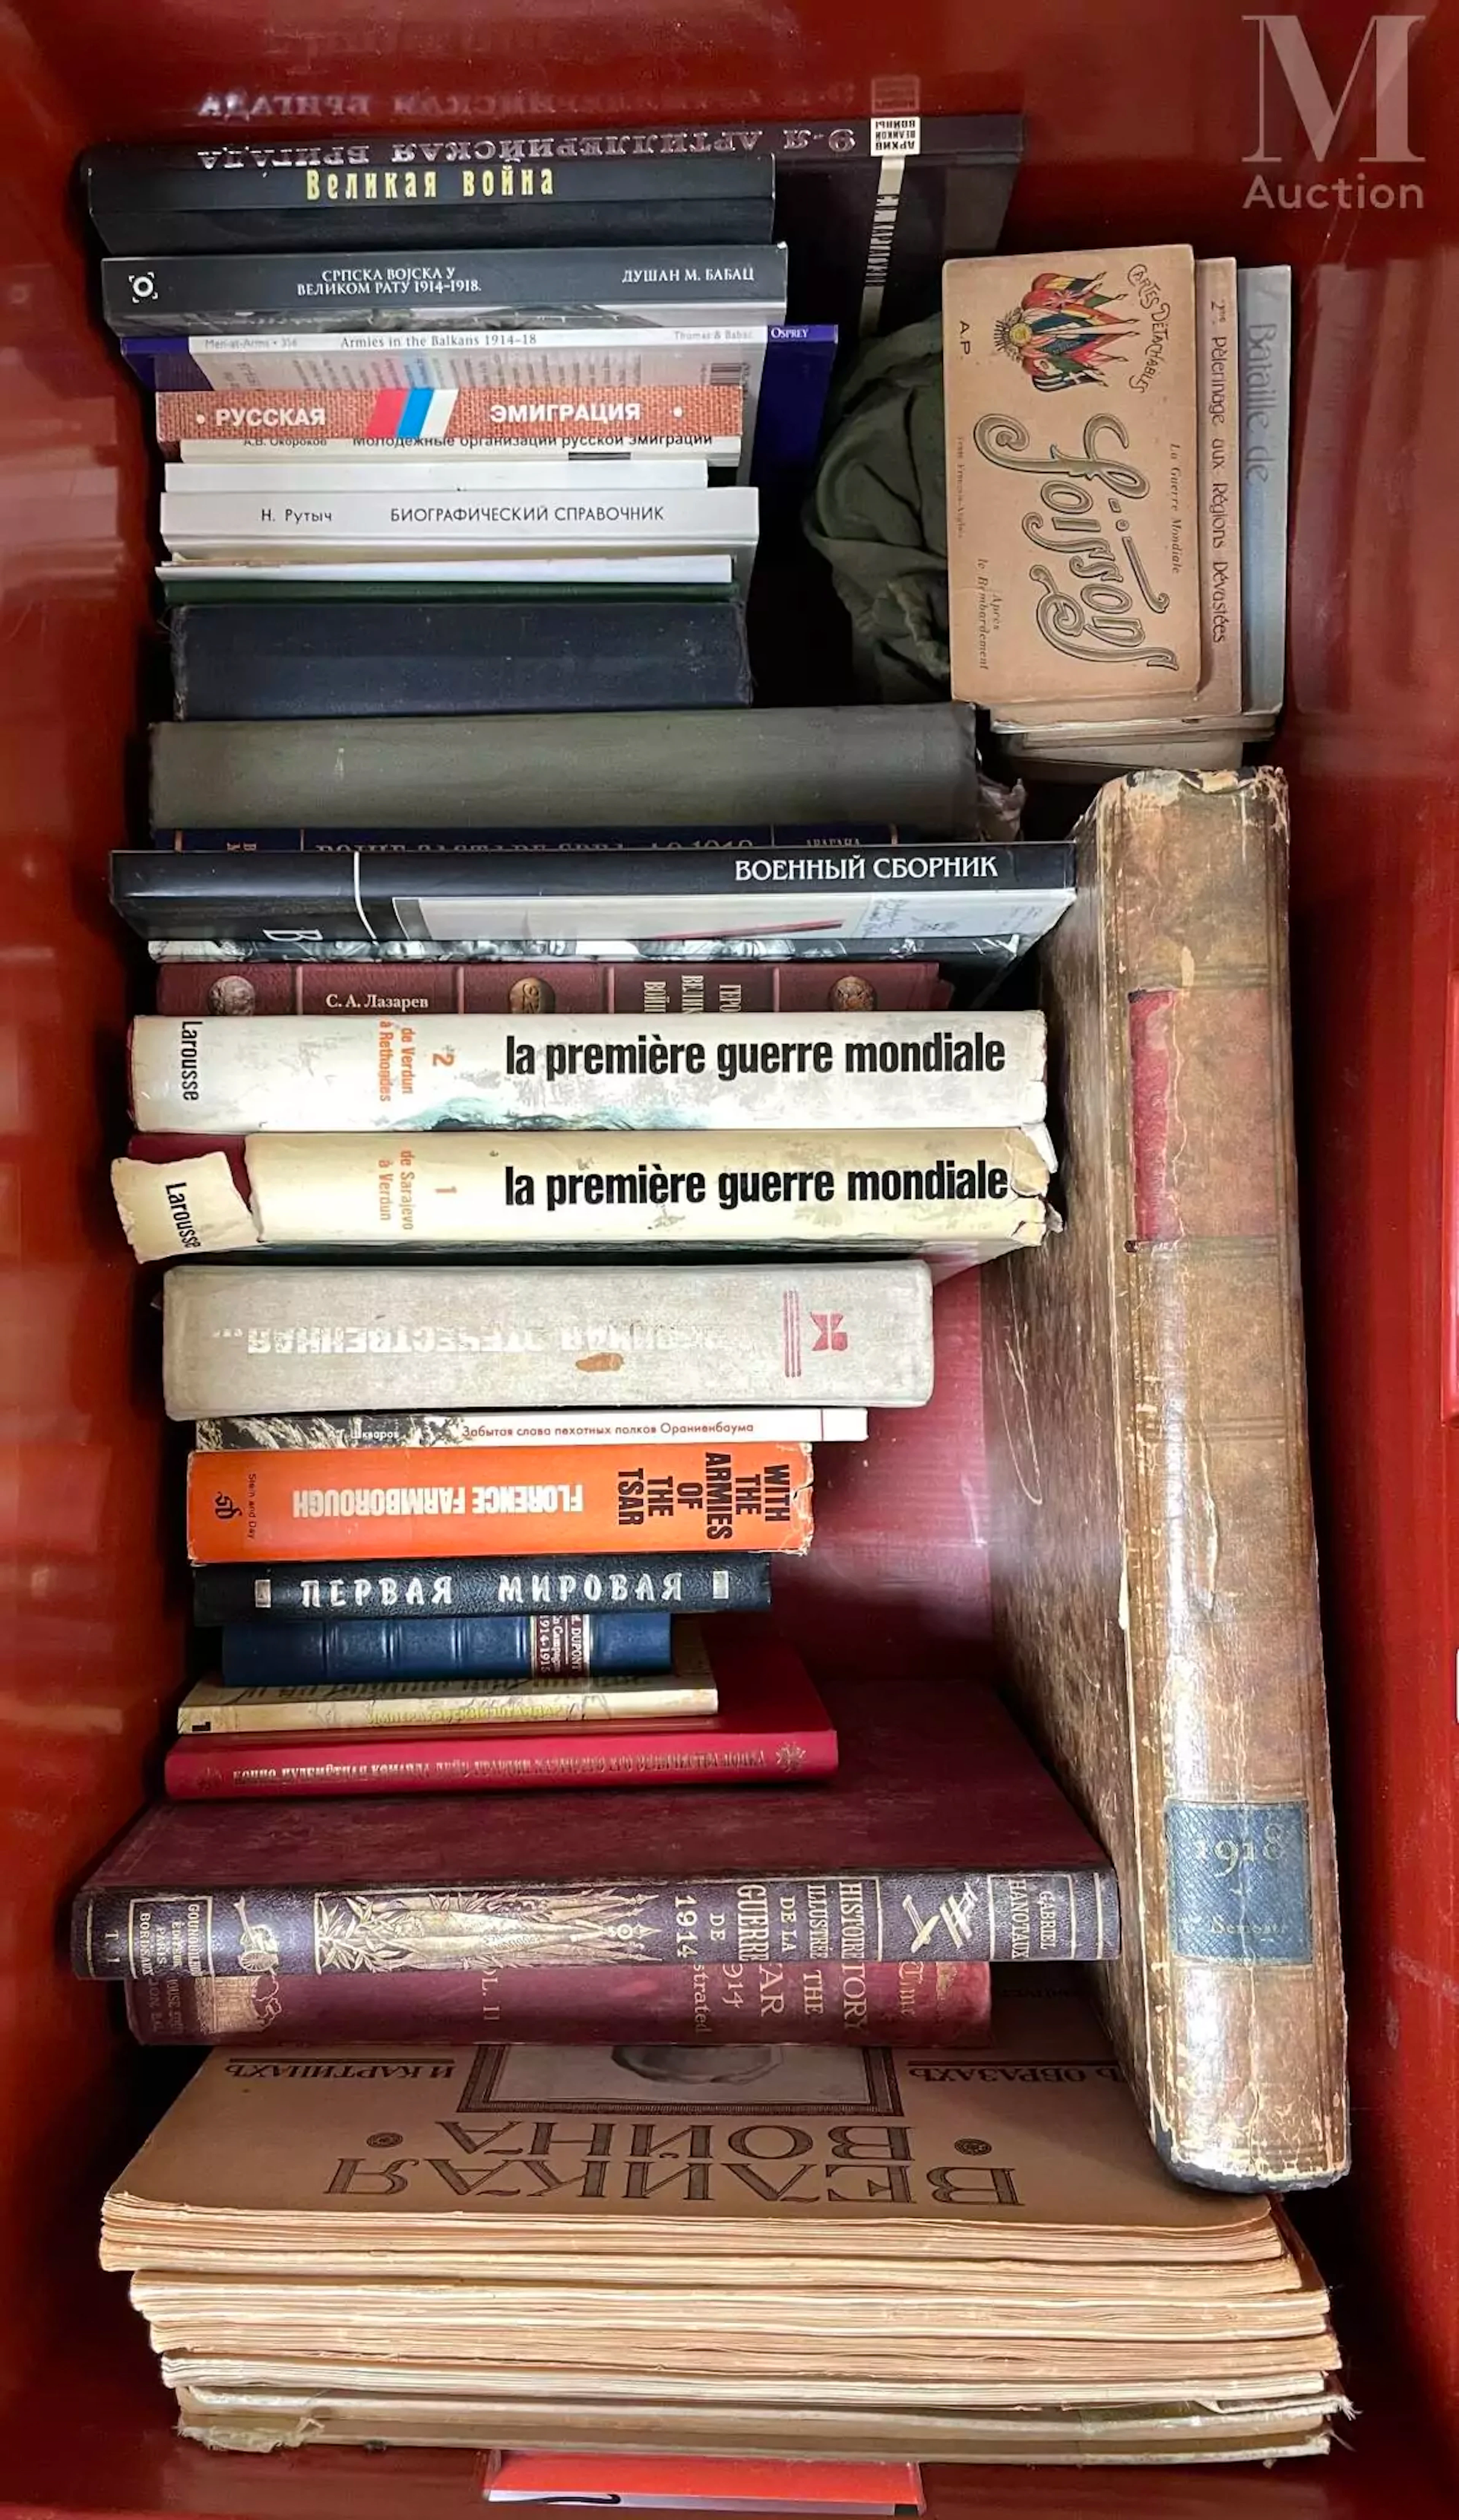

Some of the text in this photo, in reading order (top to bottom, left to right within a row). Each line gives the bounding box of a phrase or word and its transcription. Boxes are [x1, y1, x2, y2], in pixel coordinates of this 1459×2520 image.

[875, 119, 916, 129] ВОЙНЫ
[875, 129, 916, 139] ВЕЛИКОЙ
[198, 144, 370, 169] БРИГАДА
[391, 130, 763, 164] АРТИЛЛЕРИЙСКАЯ
[875, 140, 916, 151] АРХИВ
[306, 165, 554, 201] Великая война
[298, 278, 482, 296] ВЕЛИКОМ РАТУ 1914-1918.
[322, 265, 455, 280] СРПСКА ВОЈСКА У
[622, 266, 755, 284] ДУШАН М. БАБАЦ
[1127, 263, 1161, 309] CARTES
[205, 337, 269, 348] Men-at-Arms
[340, 336, 384, 348] Armies
[388, 336, 402, 347] in
[407, 335, 428, 347] the
[431, 334, 479, 347] Balkans
[674, 330, 712, 341] Thomas
[715, 330, 722, 340] &
[1210, 337, 1228, 424] Pèlerinage
[215, 407, 327, 428] РУССКАЯ
[490, 403, 641, 424] ЭМИГРАЦИЯ
[1245, 323, 1278, 483] Bataille de
[1212, 438, 1226, 470] aux
[261, 505, 664, 526] Н. Рутыч БИОГРАФИЧЕСКИЙ СПРАВОЧНИК
[1170, 443, 1183, 575] La Guerre Mondiale
[1210, 483, 1229, 549] Régions
[1212, 562, 1230, 643] Dévastées
[735, 855, 999, 881] ВОЕННЫЙ СБОРНИК
[326, 993, 429, 1011] С. А. Лазарев
[644, 980, 666, 1013] ВОЙН
[681, 974, 704, 1014] ВЕЛИК
[719, 984, 741, 1013] ГЕРО
[182, 1020, 203, 1101] Larousse
[379, 1020, 392, 1102] à Rethondes
[400, 1026, 414, 1095] de Verdun
[432, 1052, 455, 1068] 2
[506, 1032, 1005, 1082] la première guerre mondiale
[379, 1159, 391, 1221] à Verdun
[401, 1150, 415, 1231] de Sarajevo
[505, 1159, 1008, 1211] la première guerre mondiale
[166, 1182, 201, 1249] Larousse
[462, 1422, 754, 1437] Забытая слава пехотных полков Ораниенбаума
[247, 1473, 257, 1540] Stein and Day
[293, 1483, 584, 1518] FLORENCE FARMBOROUGH
[618, 1468, 644, 1525] TSAR
[647, 1476, 674, 1517] THE
[677, 1482, 703, 1509] OF
[706, 1452, 733, 1540] ARMIES
[735, 1474, 761, 1516] THE
[764, 1464, 790, 1522] WITH
[301, 1572, 683, 1608] ПЕРВАЯ МИРОВАЯ
[570, 1627, 582, 1671] DUPONT
[674, 1895, 698, 1958] 1914
[709, 1913, 725, 1941] DE
[736, 1884, 771, 1962] GUERRE
[780, 1896, 798, 1953] DE LA
[839, 1882, 865, 1961] HISTOIRE
[1009, 1879, 1031, 1959] HANOTAUX
[1038, 1890, 1057, 1950] GABRIEL
[139, 1912, 153, 1977] BORDEAUX
[156, 1927, 166, 1965] PARIS
[693, 1963, 713, 2035] strated
[722, 1962, 744, 2009] 914
[802, 1969, 824, 2015] THE
[841, 1962, 867, 2033] TORY
[224, 2064, 455, 2079] И КАРТИНАХЪ
[909, 2066, 1087, 2082] ОБРАЗАХЪ
[435, 2121, 916, 2161] ВОЙНА
[323, 2157, 1025, 2206] ВЕЛИКАЯ
